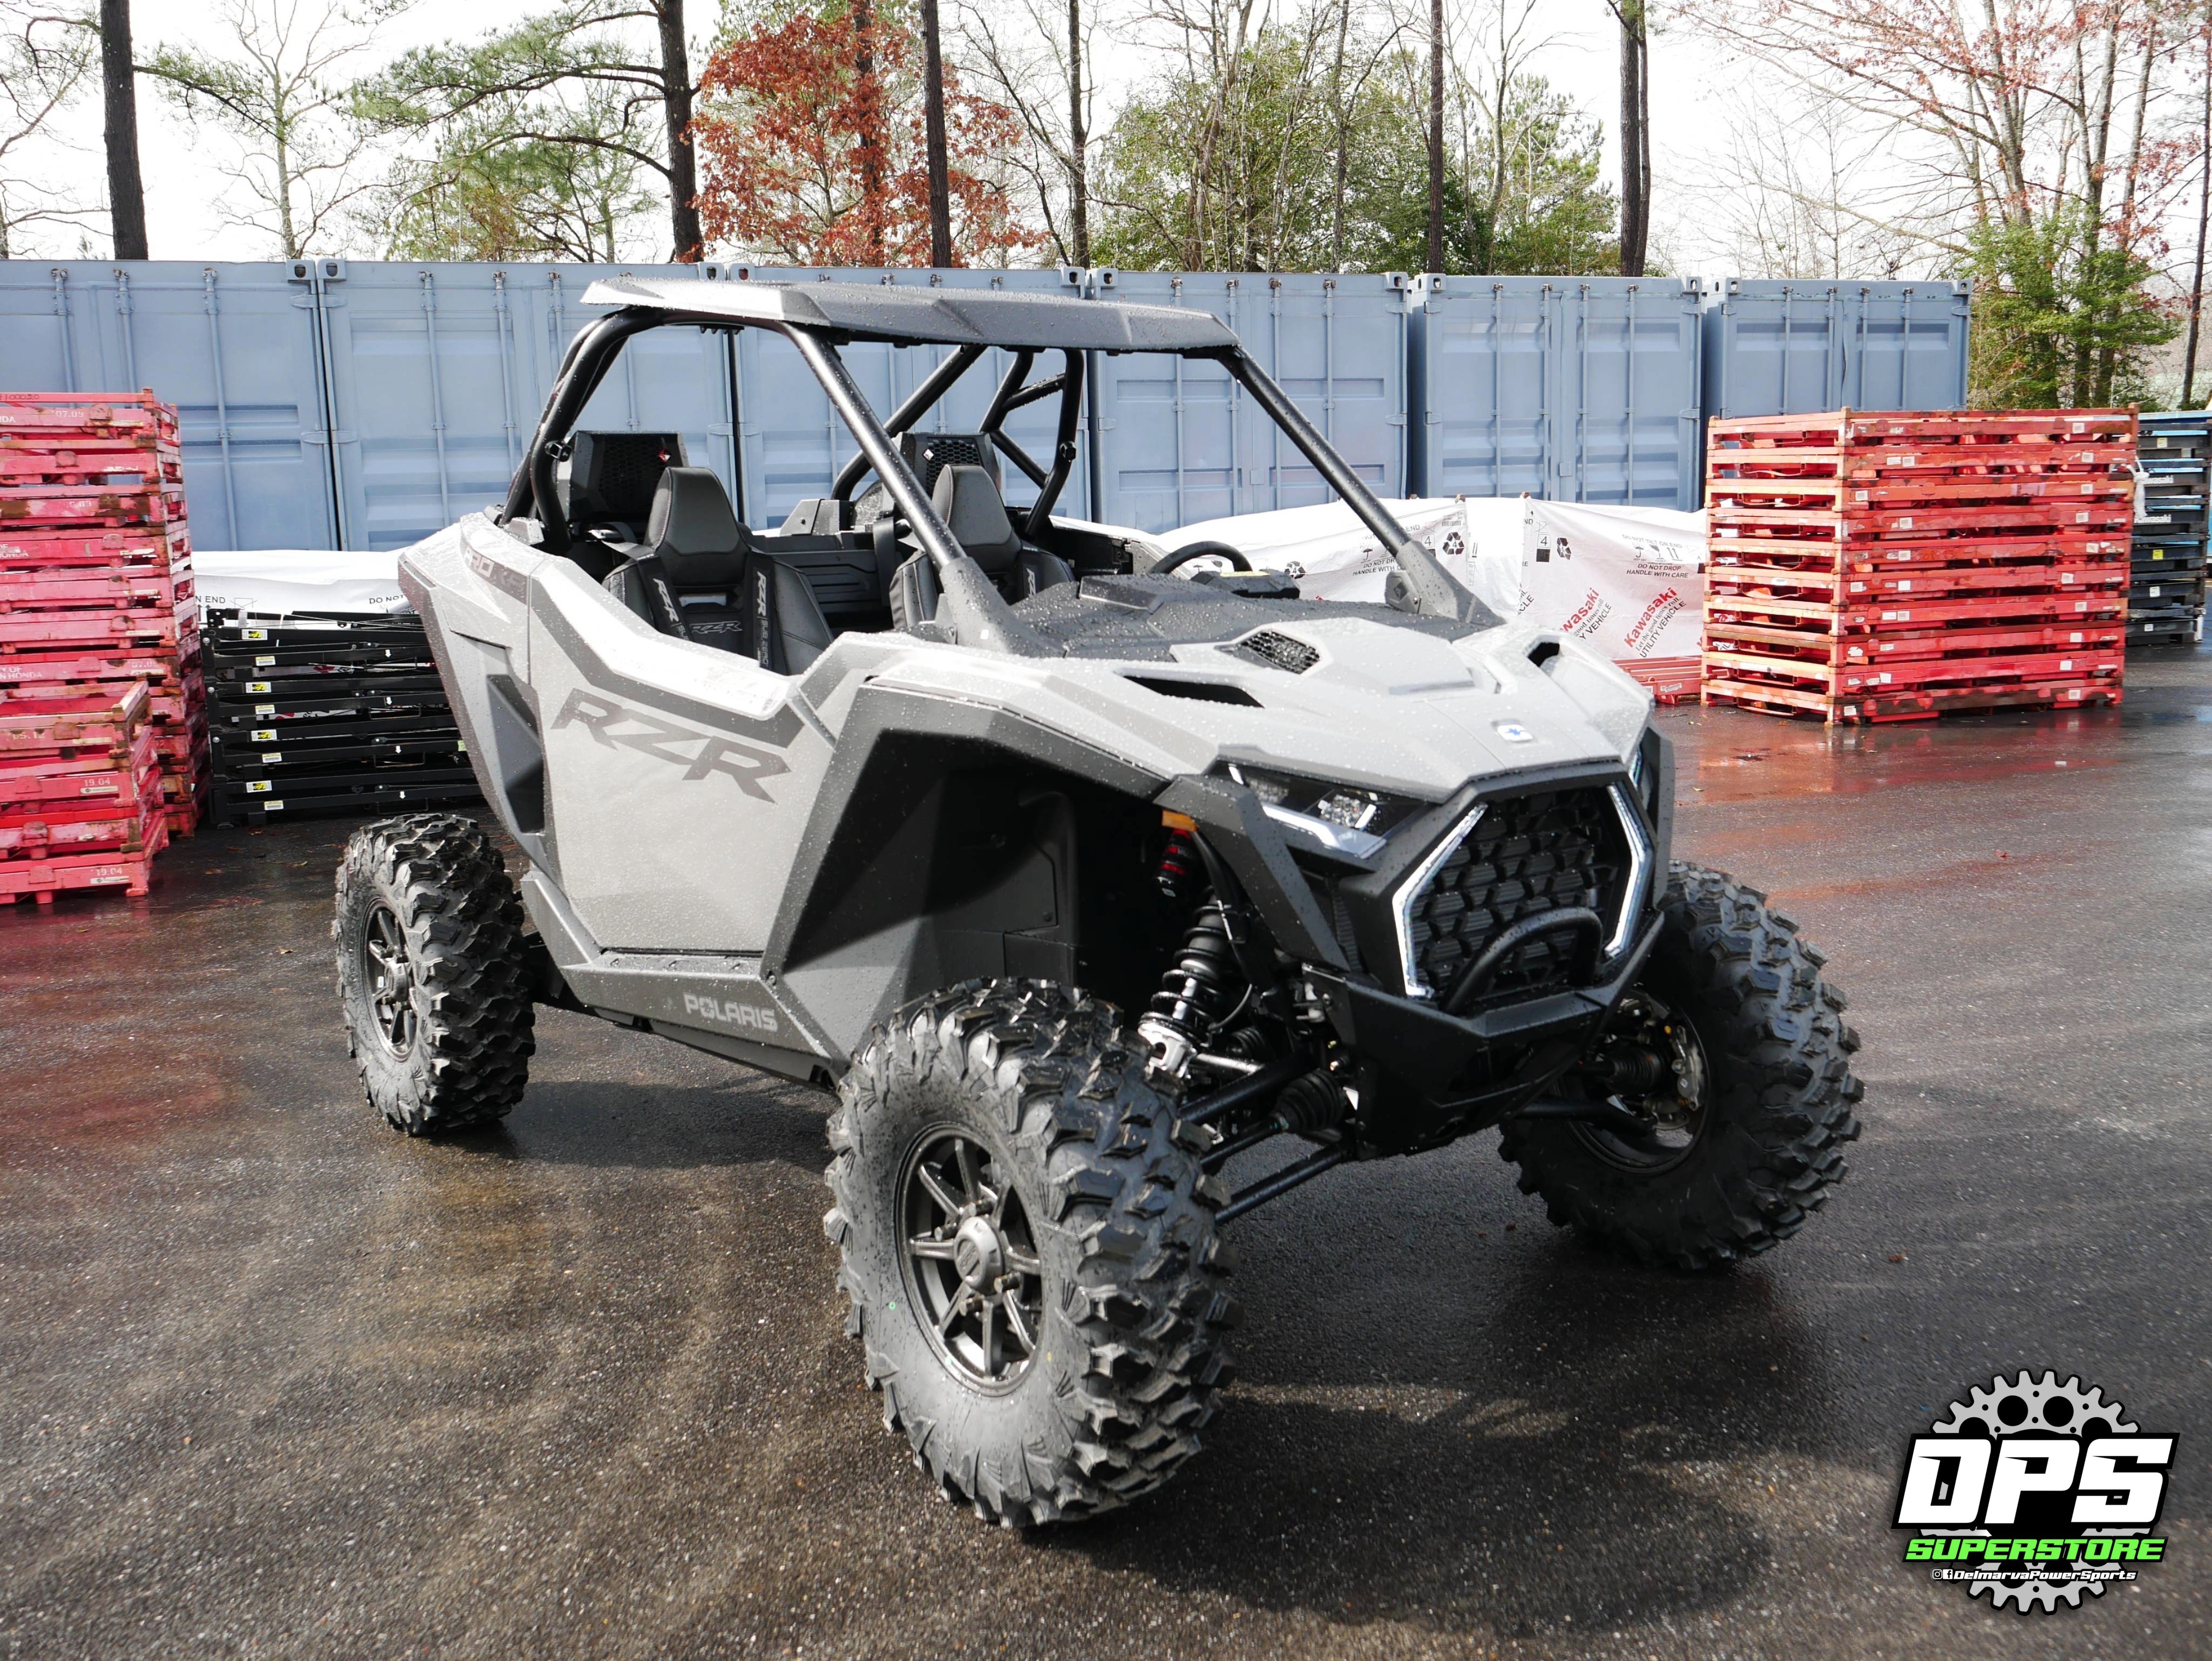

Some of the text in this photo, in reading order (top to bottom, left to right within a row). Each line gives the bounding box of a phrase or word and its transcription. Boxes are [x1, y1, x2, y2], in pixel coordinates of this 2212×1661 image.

[1424, 535, 1432, 546] 4
[1540, 536, 1548, 546] 4
[1353, 567, 1377, 576] HANDLE
[205, 595, 226, 604] END
[1585, 602, 1612, 634] VEHICLE
[1624, 587, 1678, 648] Kawasaki
[1639, 600, 1687, 658] UTILITY VEHICLE
[1648, 619, 1658, 633] good
[1656, 605, 1668, 620] times
[550, 687, 792, 805] RZR
[683, 992, 778, 1032] POLARIS
